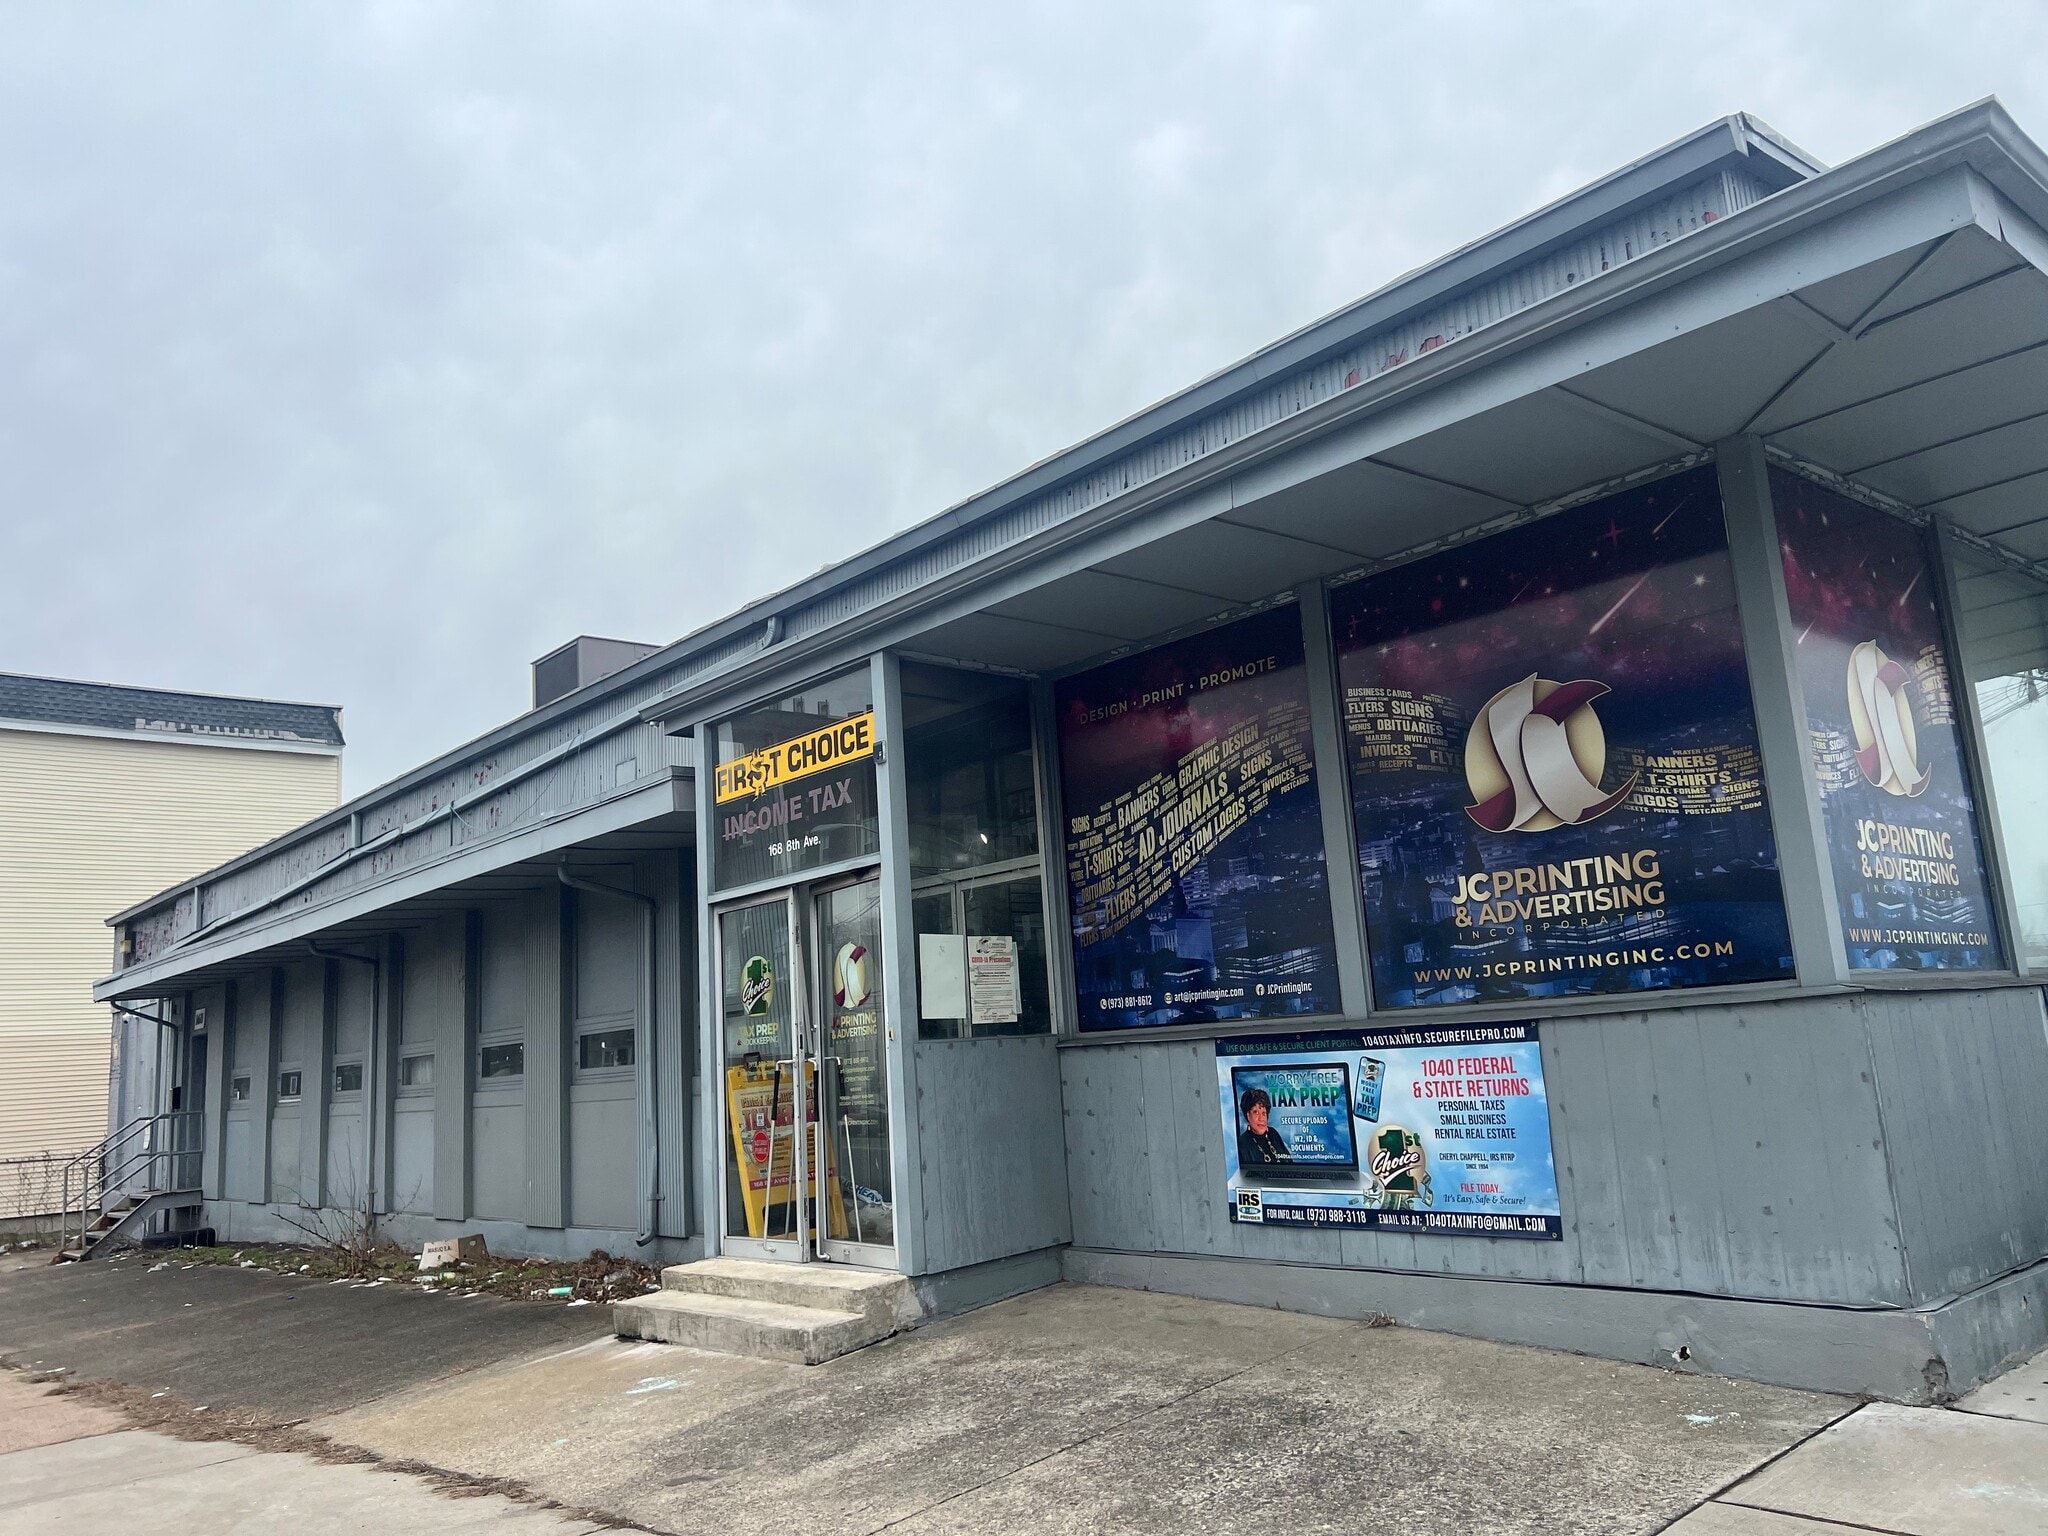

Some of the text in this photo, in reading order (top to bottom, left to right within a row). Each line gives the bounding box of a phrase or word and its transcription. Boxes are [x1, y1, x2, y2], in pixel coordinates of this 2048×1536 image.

[1080, 656, 1276, 725] DESIGN PRINT PROMOTE
[1347, 687, 1412, 699] BUSINESS CARDS
[1348, 701, 1384, 714] FLYERS
[1391, 700, 1434, 719] SIGNS
[1348, 722, 1371, 732] MENUS
[1377, 719, 1444, 736] OBITUARIES
[788, 720, 869, 772] CHOICE
[1243, 738, 1269, 759] BUSINESS
[1271, 730, 1290, 743] CARDS
[1365, 734, 1391, 742] MAILERS
[1404, 734, 1448, 747] INVITATIONS
[1179, 723, 1259, 789] GRAPHIC DESIGN
[1361, 744, 1411, 758] INVOICES
[1703, 744, 1729, 753] CARDS
[1241, 750, 1272, 781] SIGNS
[1379, 760, 1413, 768] RECEIPTS
[1632, 754, 1717, 768] BANNERS
[1724, 756, 1759, 769] POSTERS
[1262, 768, 1295, 794] INVOICES
[1281, 775, 1309, 794] POSTCARDS
[1647, 770, 1731, 786] T-SHIRTS
[1722, 779, 1759, 793] SIGNS
[1626, 794, 1679, 808] LOGOS
[1715, 790, 1761, 802] BROCHURES
[723, 778, 852, 841] INCOME TAX
[1117, 786, 1160, 830] BANNERS
[1249, 799, 1268, 816] T-SHIRTS
[1685, 806, 1732, 815] POSTCARDS
[1740, 801, 1762, 811] EDDM
[1071, 814, 1090, 834] SIGNS
[1139, 771, 1228, 864] AD JOURNALS
[1172, 821, 1212, 872] CUSTOM
[1214, 797, 1245, 835] LOGOS
[1857, 819, 1954, 859] JCPRINTING
[768, 835, 821, 857] 168 8th Ave.
[1084, 841, 1123, 879] T-SHIRTS
[1451, 849, 1660, 905] JCPRINTING
[1861, 854, 1959, 886] & ADVERTISING
[1081, 875, 1115, 903] OBITUARIES
[1867, 884, 1961, 899] INCORPORATED
[1104, 884, 1136, 924] FLYERS
[1455, 881, 1665, 928] & ADVERTISING
[1459, 908, 1665, 941] INCORPORATED
[1849, 928, 1988, 945] WWW.JCPRINTINGINC.COM
[1414, 940, 1734, 984] WWW.JCPRINTINGINC.COM
[742, 976, 771, 1004] Choice
[1174, 987, 1244, 1003] art@jcprintinginc.com
[1267, 981, 1312, 995] JCPrintingInc
[1108, 994, 1152, 1010] (973) 881-8612
[756, 1022, 779, 1036] PREP
[831, 1032, 838, 1040] &
[838, 1024, 877, 1039] ADVERTISING
[1226, 1044, 1238, 1052] USE
[1240, 1043, 1255, 1052] OUR
[1255, 1042, 1272, 1051] SAFE
[1279, 1041, 1304, 1050] SECURE
[1306, 1040, 1330, 1049] CLIENT
[1332, 1038, 1361, 1048] PORTAL:
[1362, 1026, 1525, 1047] 1040TAXINFO.SECUREFILEPRO.COM
[1421, 1056, 1517, 1077] 1040 FEDERAL
[1266, 1072, 1338, 1085] WORRY-FREE
[1362, 1086, 1374, 1094] FREE
[1413, 1078, 1530, 1098] & STATE RETURNS
[1269, 1086, 1340, 1107] TAX PREP
[1361, 1093, 1375, 1106] TAX
[1357, 1102, 1377, 1116] PREP
[1438, 1100, 1505, 1112] PERSONAL TAXES
[1281, 1116, 1328, 1125] SECURE UPLOADS
[1440, 1114, 1506, 1125] SMALL BUSINESS
[1306, 1135, 1313, 1143] ID
[1434, 1128, 1516, 1139] RENTAL REAL ESTATE
[1291, 1144, 1325, 1152] DOCUMENTS
[1372, 1151, 1420, 1177] Choice
[1439, 1153, 1459, 1161] CHERYL
[1460, 1153, 1489, 1162] CHAPPELL,
[1490, 1153, 1500, 1161] IRS
[1460, 1183, 1476, 1193] FILE
[1238, 1193, 1260, 1206] IRS
[1443, 1194, 1526, 1205] It's Easy, Safe & Secure!
[1266, 1209, 1277, 1218] FOR
[1291, 1210, 1305, 1220] CALL
[1307, 1208, 1327, 1222] (973)
[1328, 1210, 1366, 1223] 988-3118
[1378, 1214, 1399, 1225] EMAIL
[1400, 1215, 1410, 1225] US
[1411, 1216, 1422, 1226] AT:
[1425, 1214, 1546, 1232] 1040TAXINFO@GMAIL.COM
